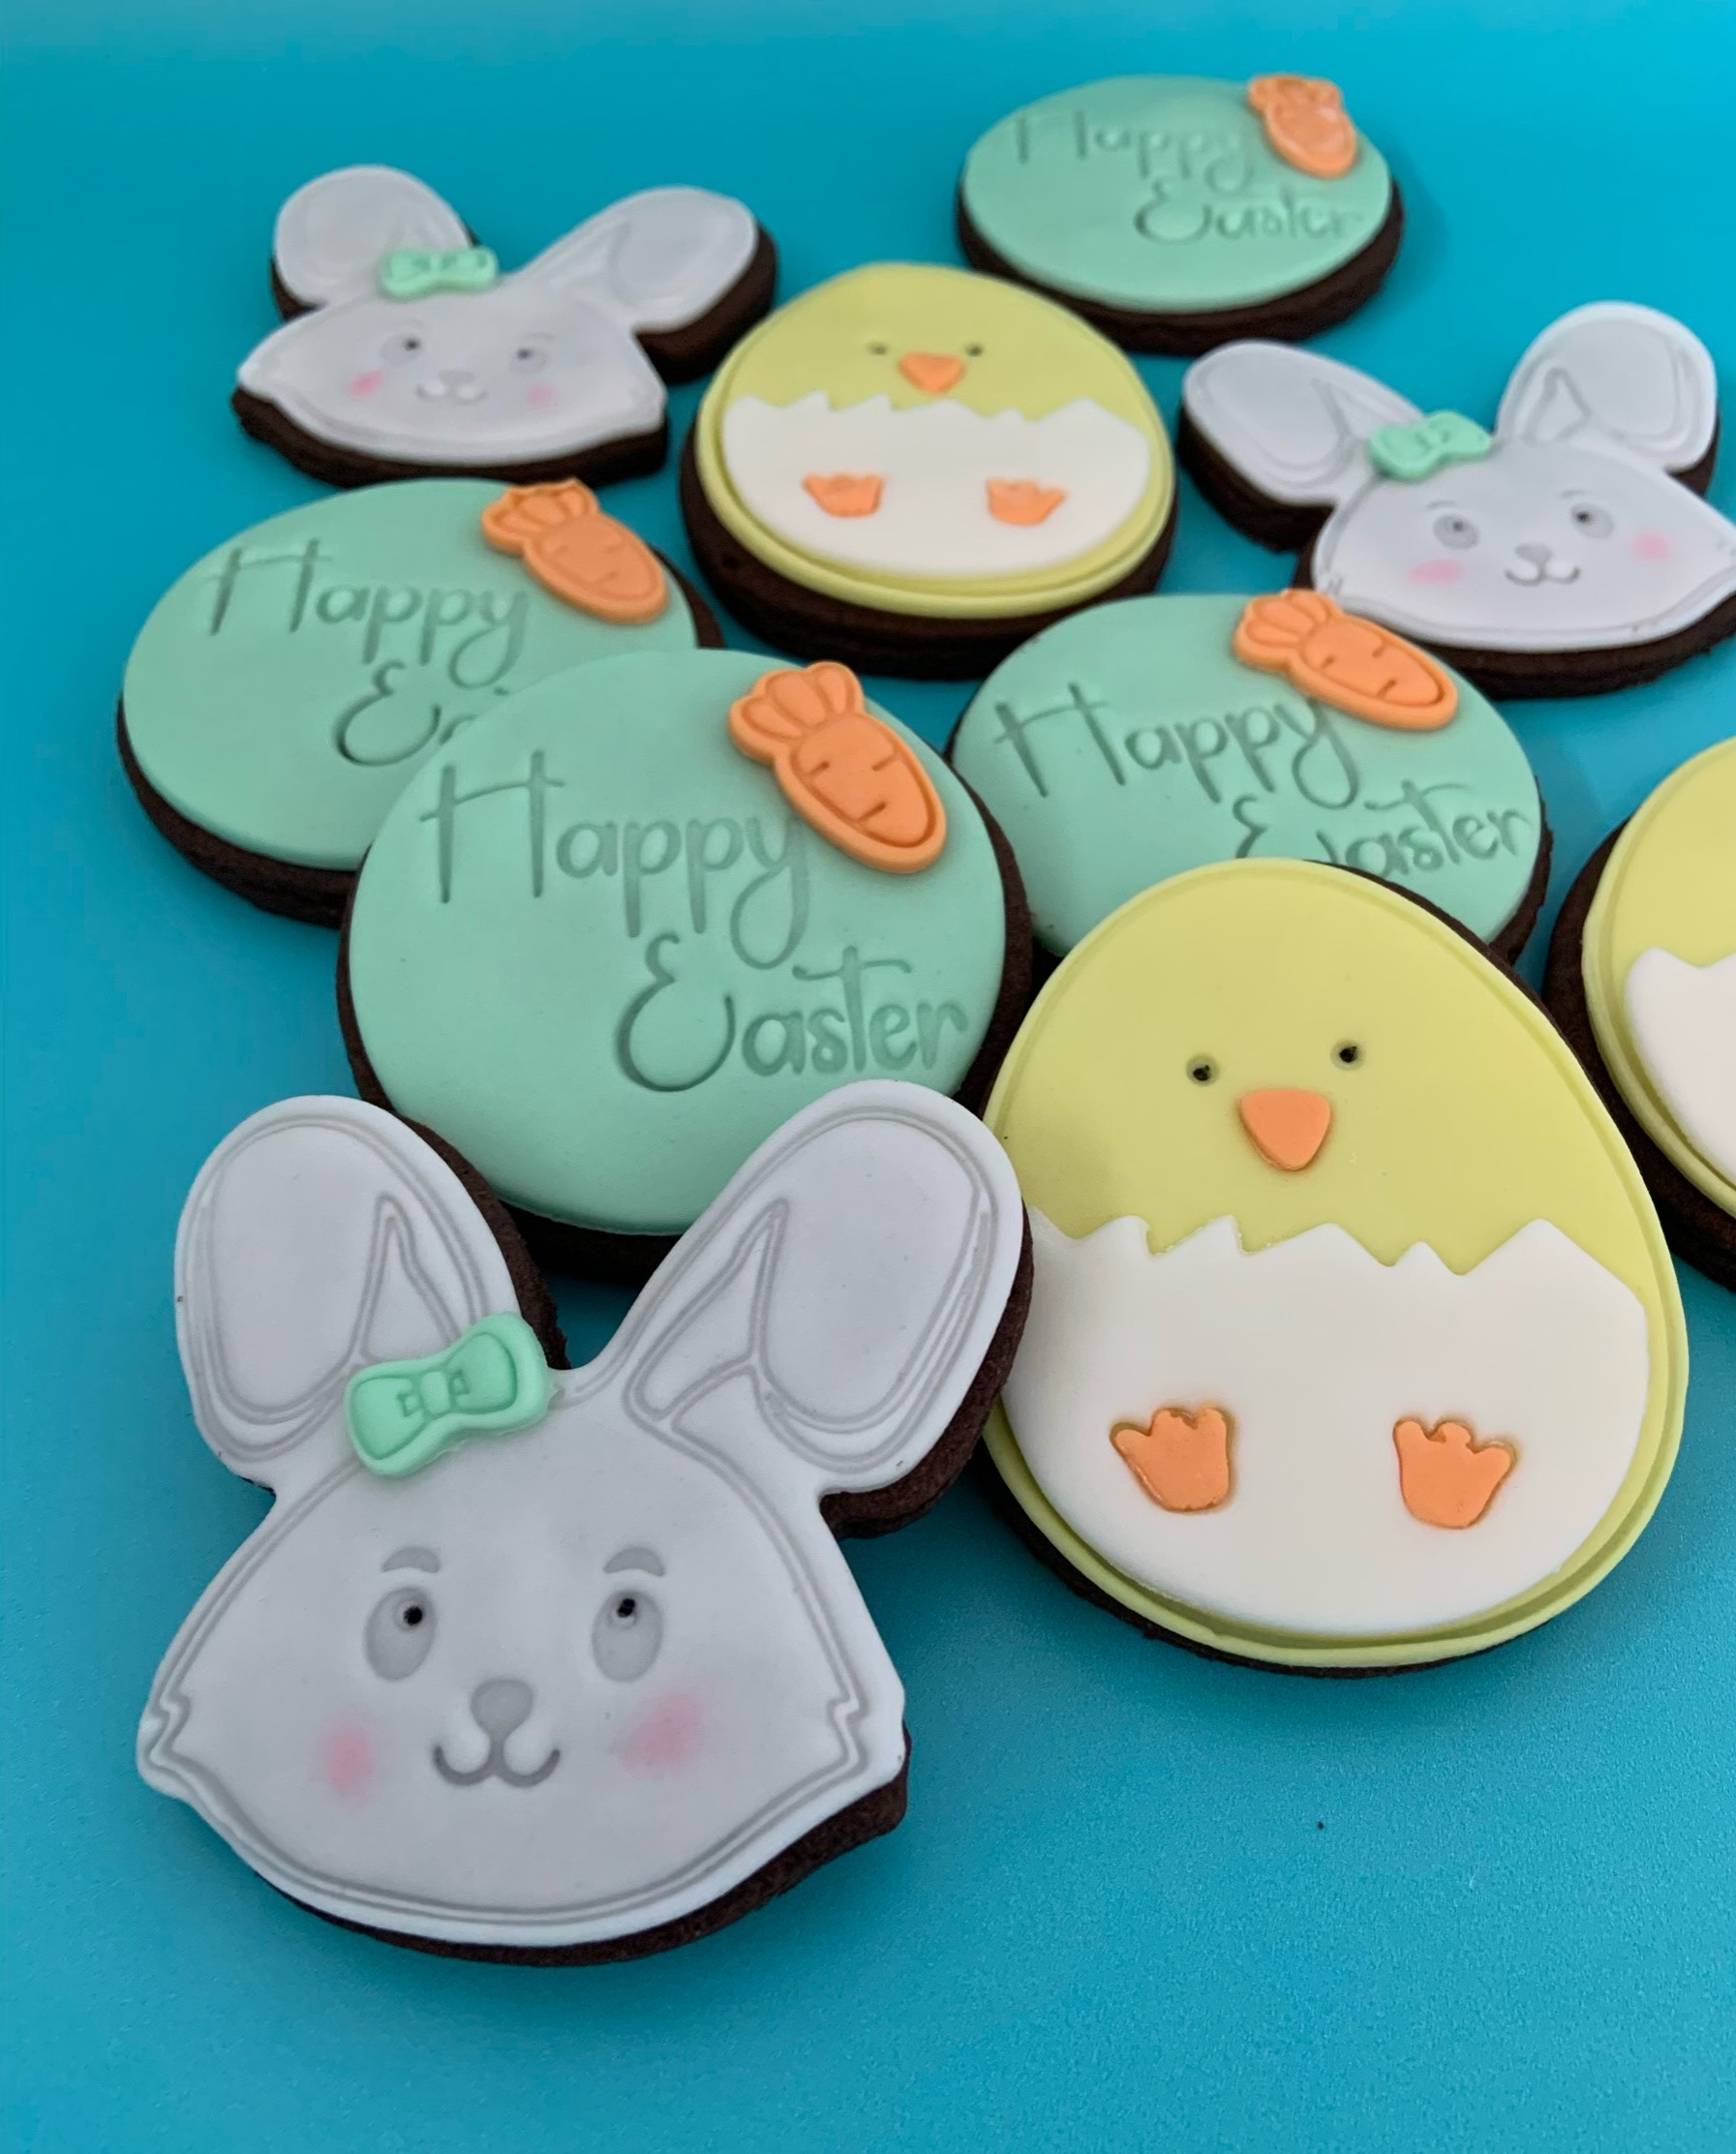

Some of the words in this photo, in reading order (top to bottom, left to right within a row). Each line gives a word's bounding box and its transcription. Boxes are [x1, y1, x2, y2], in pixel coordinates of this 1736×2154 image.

[1015, 108, 1256, 193] Happy
[1133, 174, 1362, 244] Easter
[198, 538, 528, 689] Happy
[993, 682, 1357, 810] Happy
[419, 748, 810, 969] Happy
[614, 932, 968, 1092] Easter
